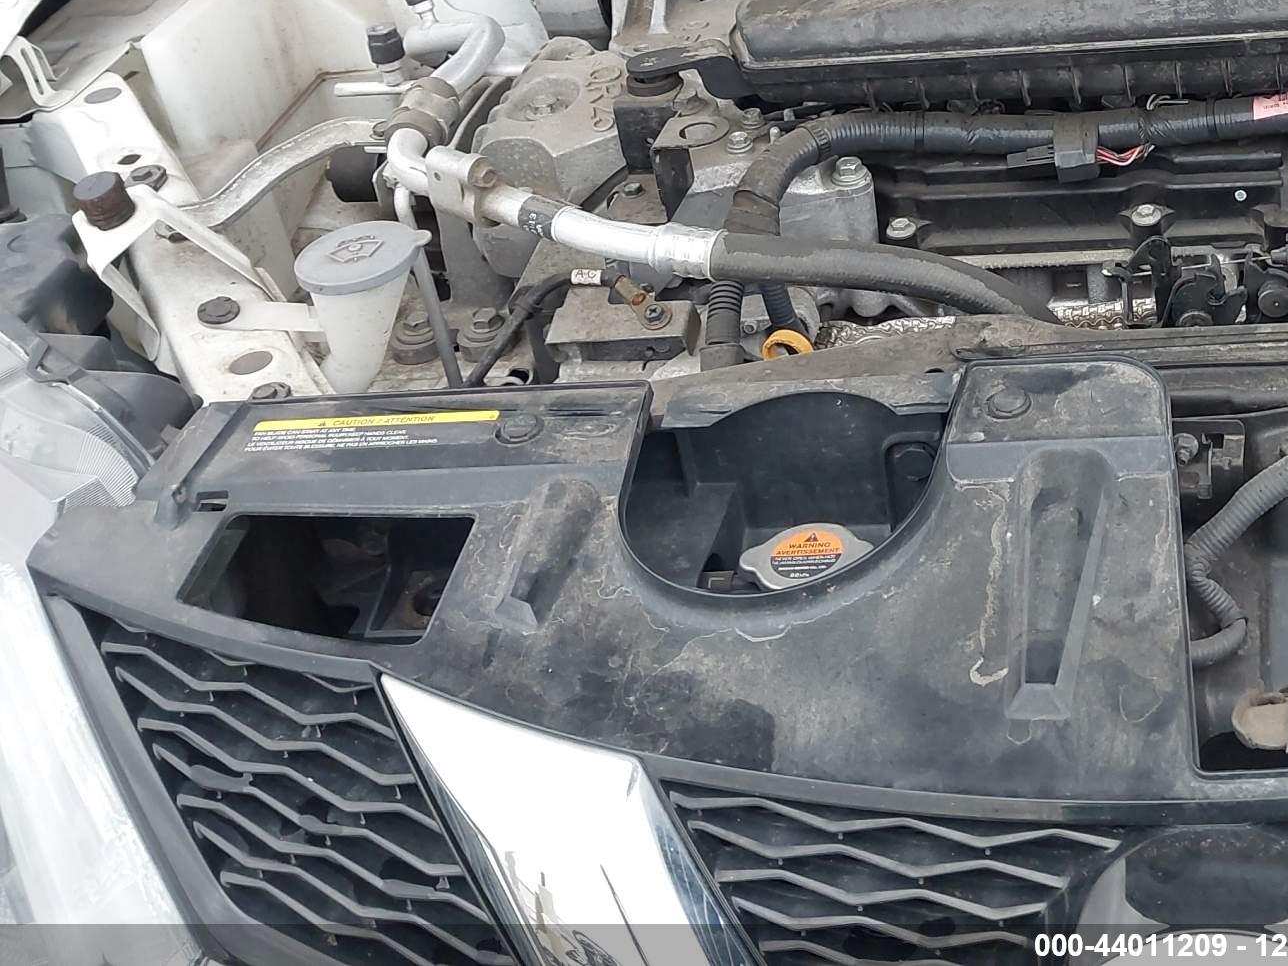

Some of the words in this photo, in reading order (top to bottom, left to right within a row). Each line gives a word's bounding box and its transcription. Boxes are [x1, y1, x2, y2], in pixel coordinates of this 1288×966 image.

[333, 418, 375, 426] CAUTION
[385, 415, 436, 423] ATTENTION
[776, 547, 840, 556] AVERTISSEMENT
